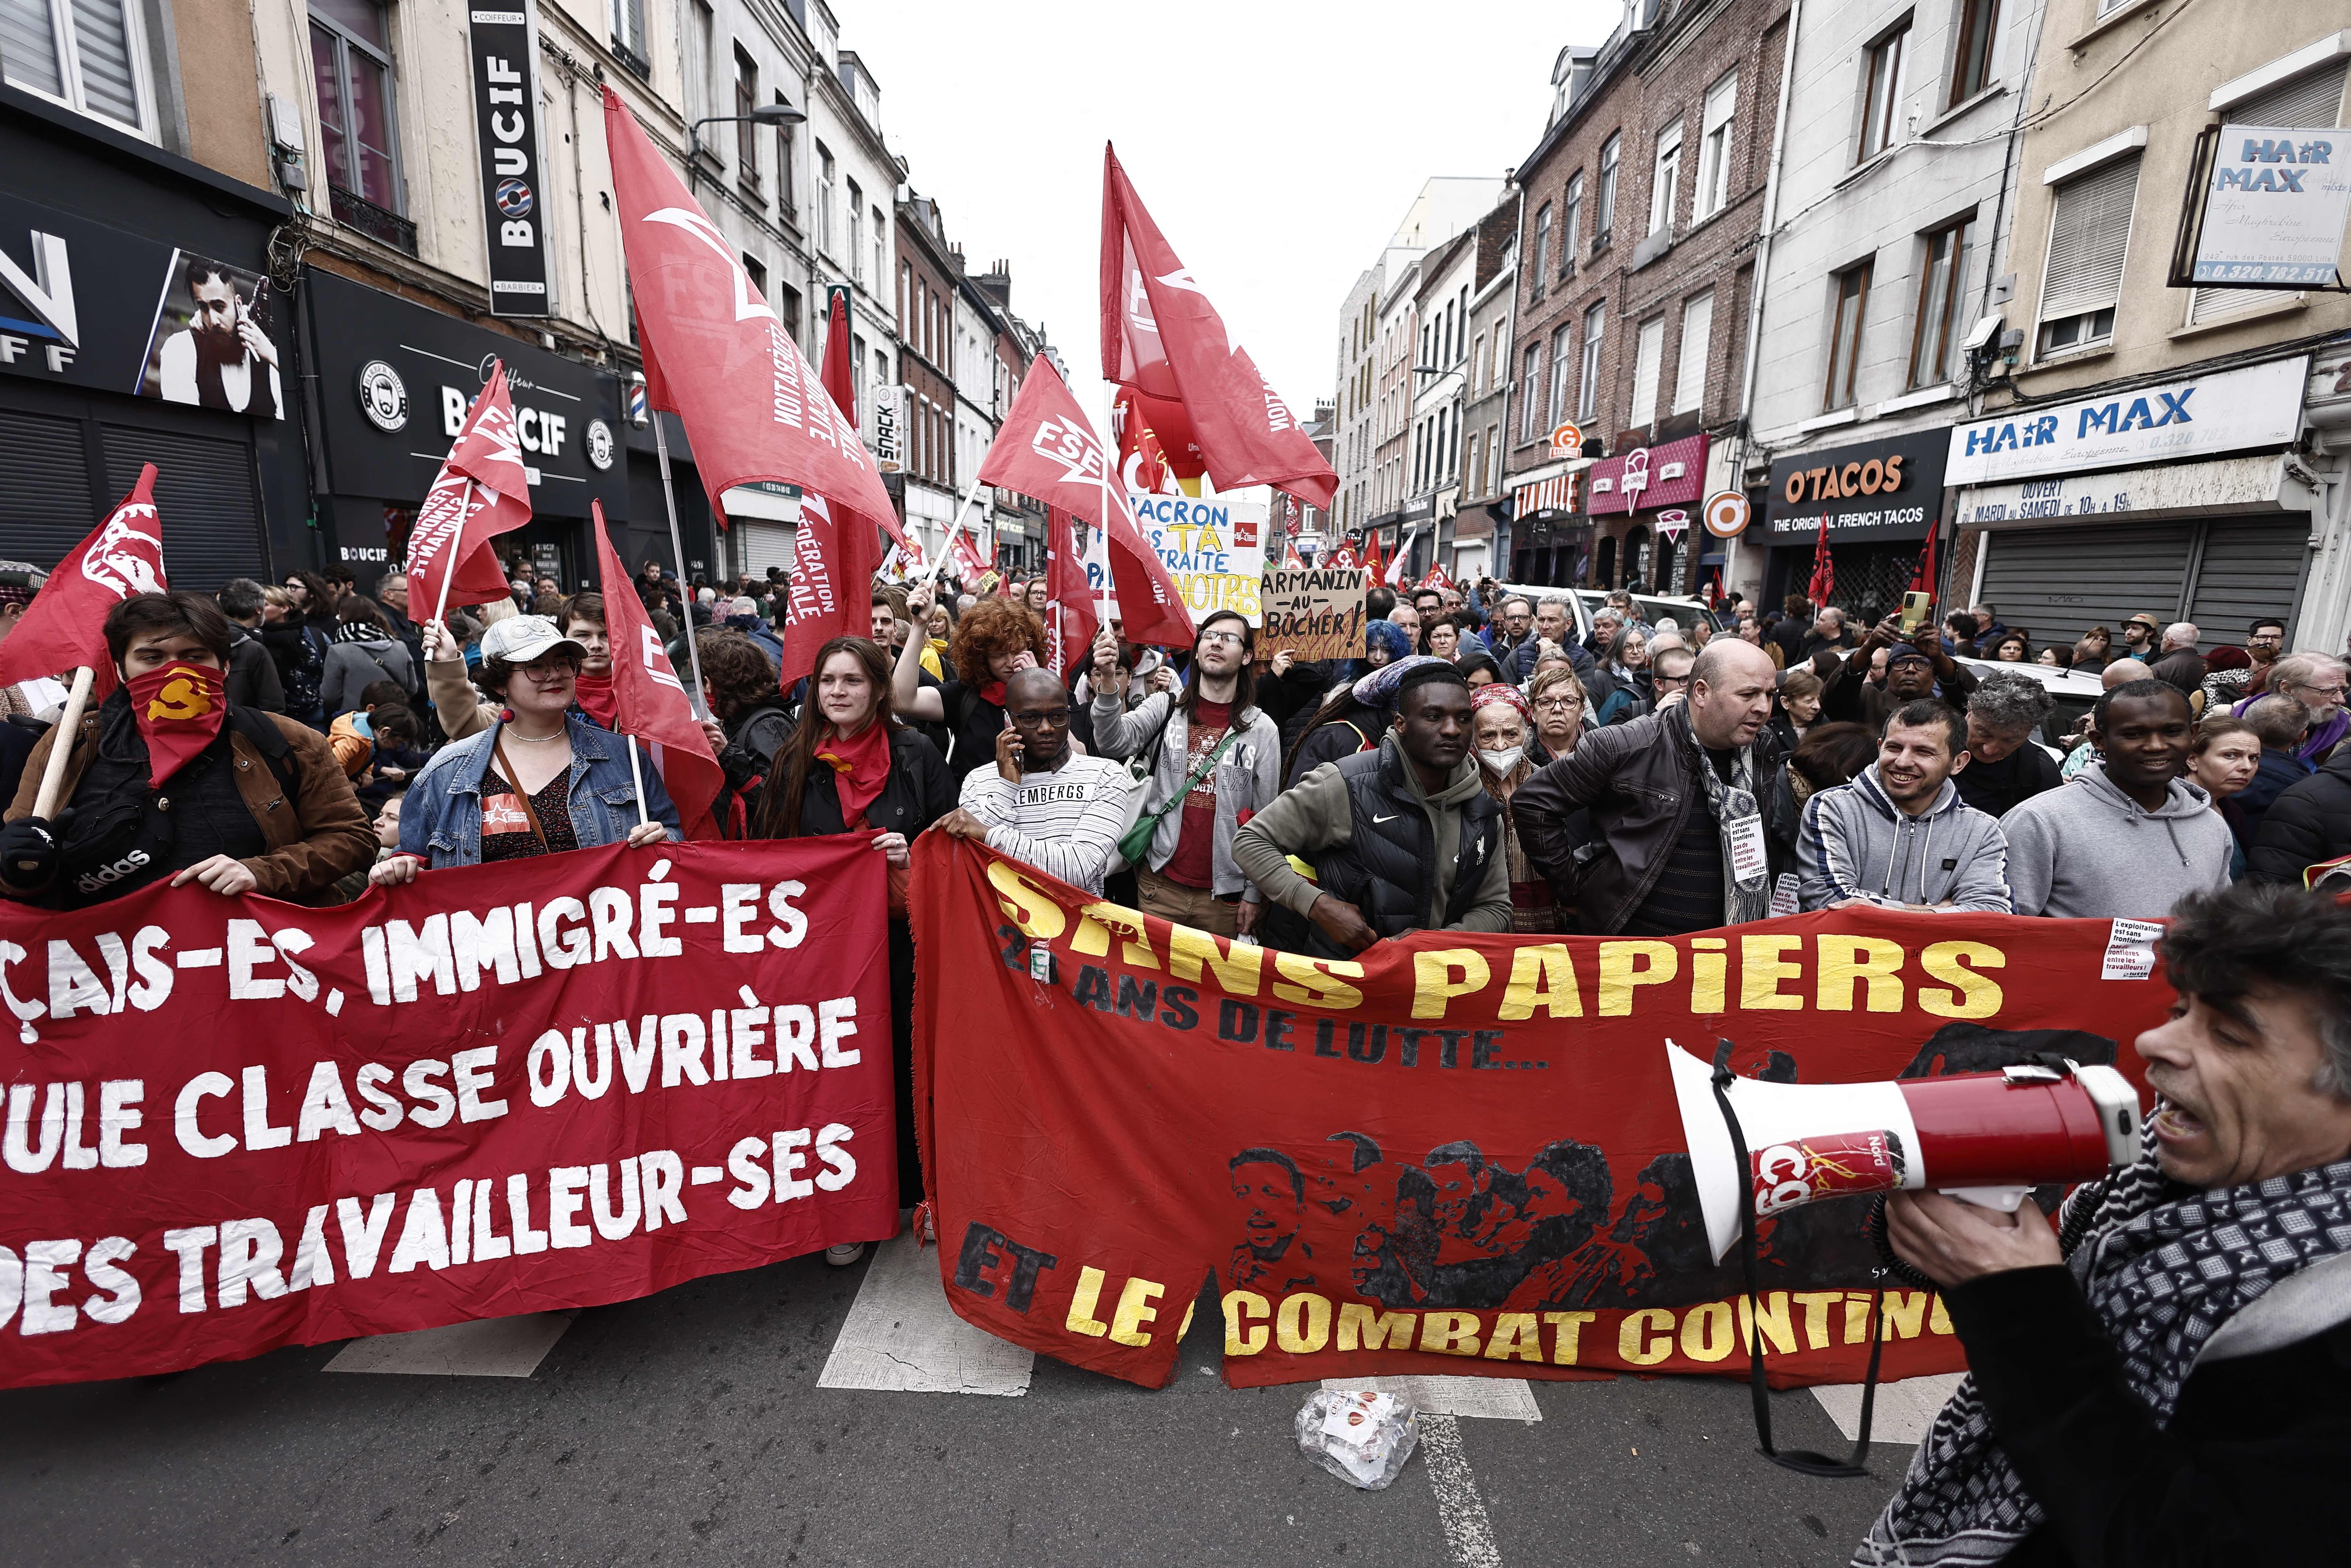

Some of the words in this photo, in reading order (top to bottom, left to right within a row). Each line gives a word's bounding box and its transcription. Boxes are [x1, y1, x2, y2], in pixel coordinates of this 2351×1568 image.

[479, 12, 518, 23] COIFFEUR
[486, 56, 535, 247] BOUCIF
[2216, 167, 2309, 193] MAX
[500, 282, 537, 292] BARBIER
[2076, 386, 2197, 440] MAX
[877, 404, 894, 460] SNACK
[1558, 430, 1577, 448] G
[1785, 454, 1903, 504] O'TACOS
[2022, 480, 2065, 499] OUVERT
[1131, 496, 1228, 527] ACRON
[1774, 519, 1791, 532] THE
[1838, 511, 1881, 528] FRENCH
[1884, 506, 1924, 525] TACOS
[1976, 504, 2007, 523] MARDI
[2009, 509, 2017, 520] AU
[2020, 499, 2061, 519] SAMEDI
[2064, 504, 2073, 515] DE
[1167, 522, 1223, 553] TA
[340, 546, 388, 562] BOUCIF
[1265, 611, 1344, 639] BÛCHER
[1732, 816, 1761, 828] L'exploitation
[1734, 847, 1755, 857] frontières
[1735, 856, 1748, 864] entre
[73, 850, 150, 894] didas
[362, 859, 809, 1005] IMMIGRÉ-ES
[986, 859, 1365, 1010] SANS
[2115, 921, 2163, 933] L'exploitation
[1072, 964, 1199, 1031] ANS
[1218, 998, 1296, 1052] DE
[0, 1079, 148, 1174] ULE
[174, 1046, 509, 1158] CLASSE
[527, 984, 860, 1108] OUVRIÈRE
[1868, 1135, 1886, 1166] Nord
[164, 1123, 857, 1313] TRAVAILLEUR-SES
[955, 1221, 1058, 1314] ET
[1065, 1265, 1165, 1347] LE
